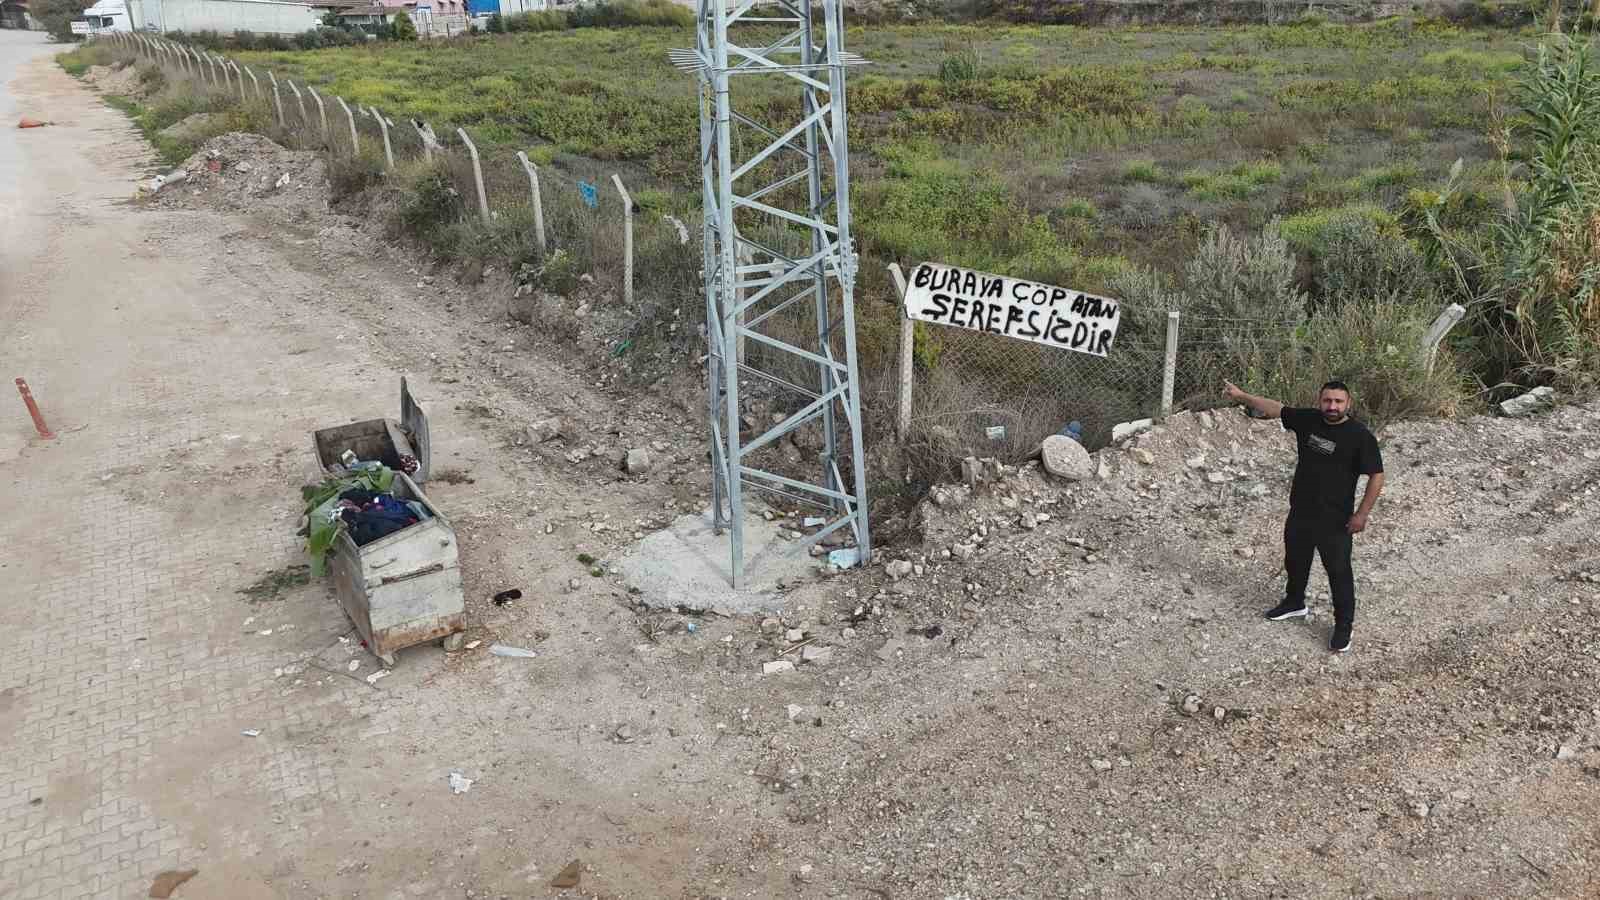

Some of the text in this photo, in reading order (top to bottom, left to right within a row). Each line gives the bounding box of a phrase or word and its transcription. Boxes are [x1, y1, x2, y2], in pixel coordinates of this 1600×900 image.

[915, 265, 1117, 319] BURAYA ÇÖP ATAN
